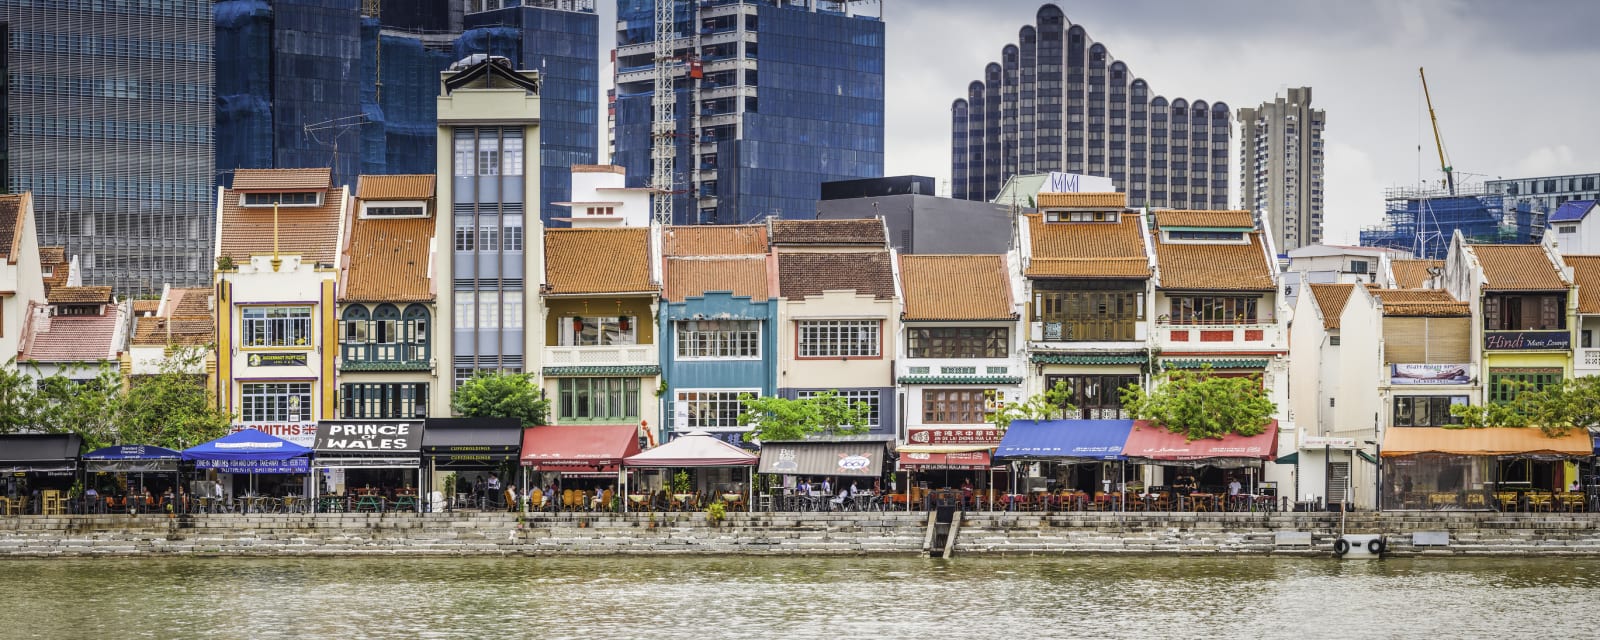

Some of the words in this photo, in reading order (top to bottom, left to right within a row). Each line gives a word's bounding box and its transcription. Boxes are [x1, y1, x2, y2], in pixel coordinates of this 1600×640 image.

[1488, 333, 1524, 349] Hindi
[329, 423, 410, 436] PRINCE
[327, 438, 408, 449] WALES
